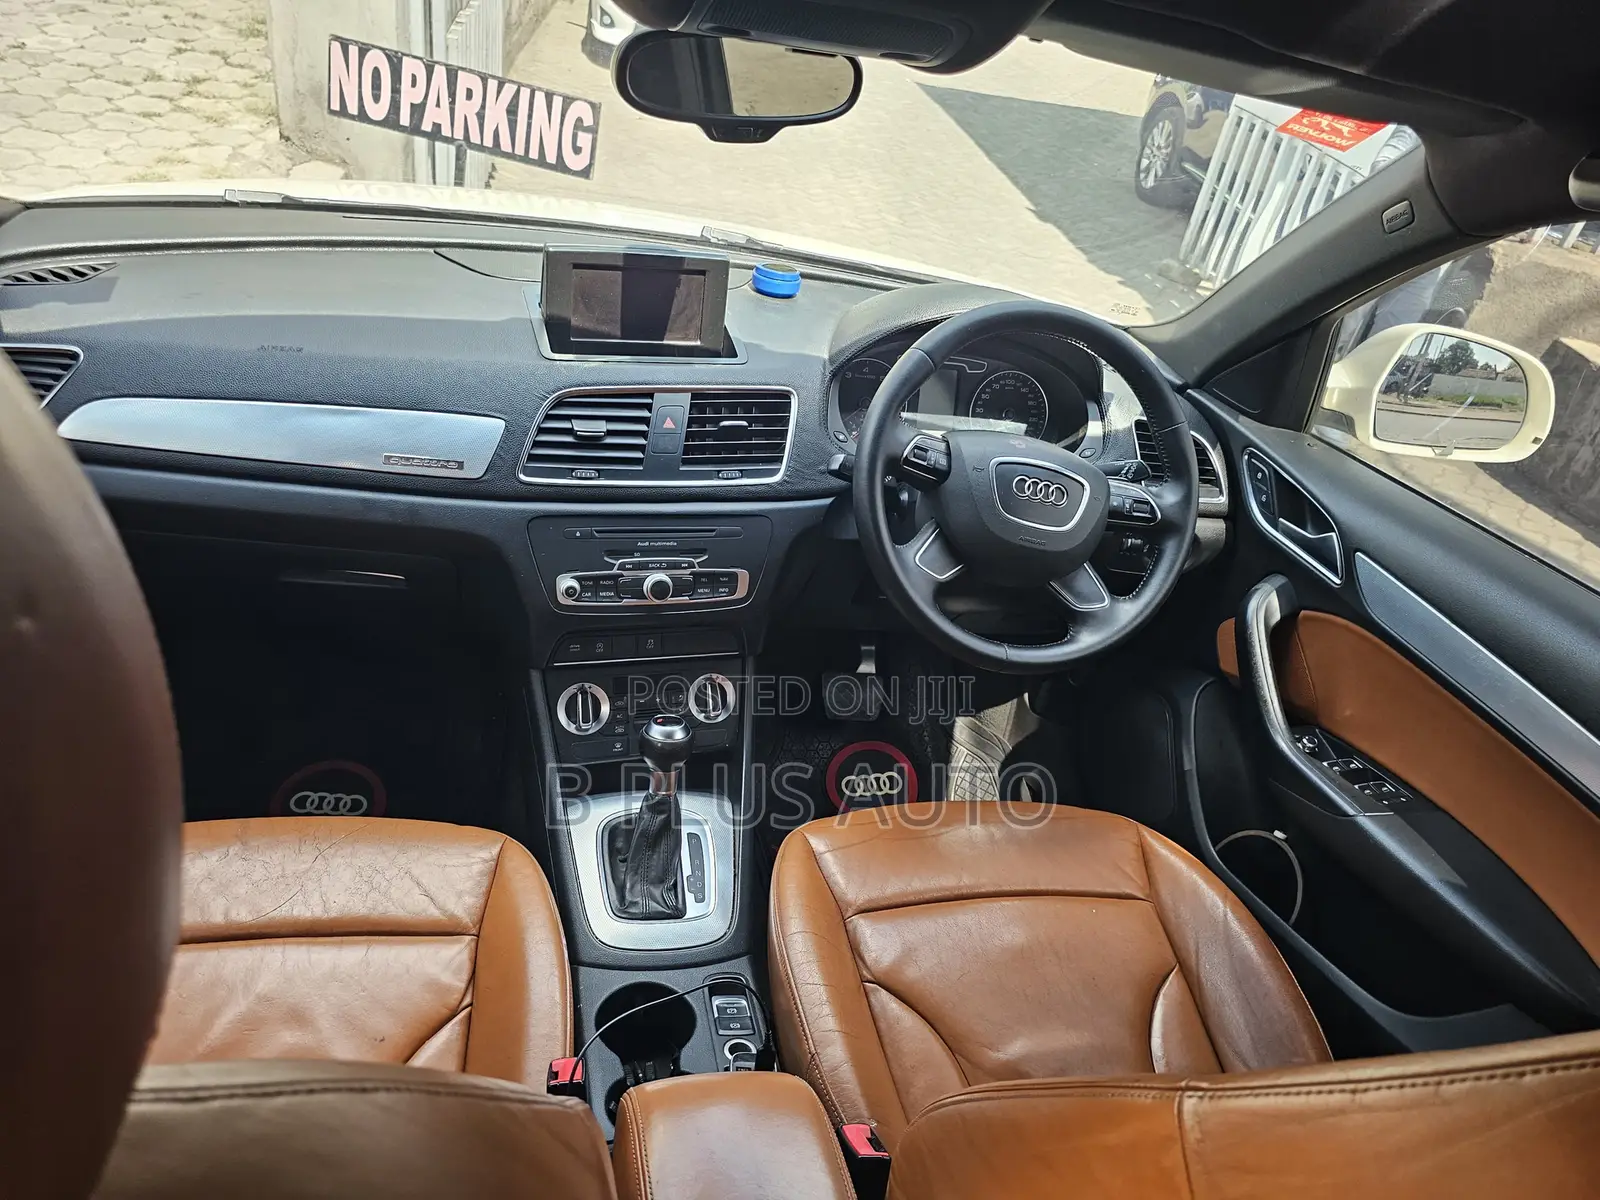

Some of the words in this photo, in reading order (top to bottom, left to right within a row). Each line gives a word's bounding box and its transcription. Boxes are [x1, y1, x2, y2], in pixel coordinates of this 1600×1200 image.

[330, 41, 391, 121] NO
[400, 56, 593, 171] PARKING
[1386, 209, 1409, 225] AIRBAG
[1018, 535, 1047, 547] AIRBAG
